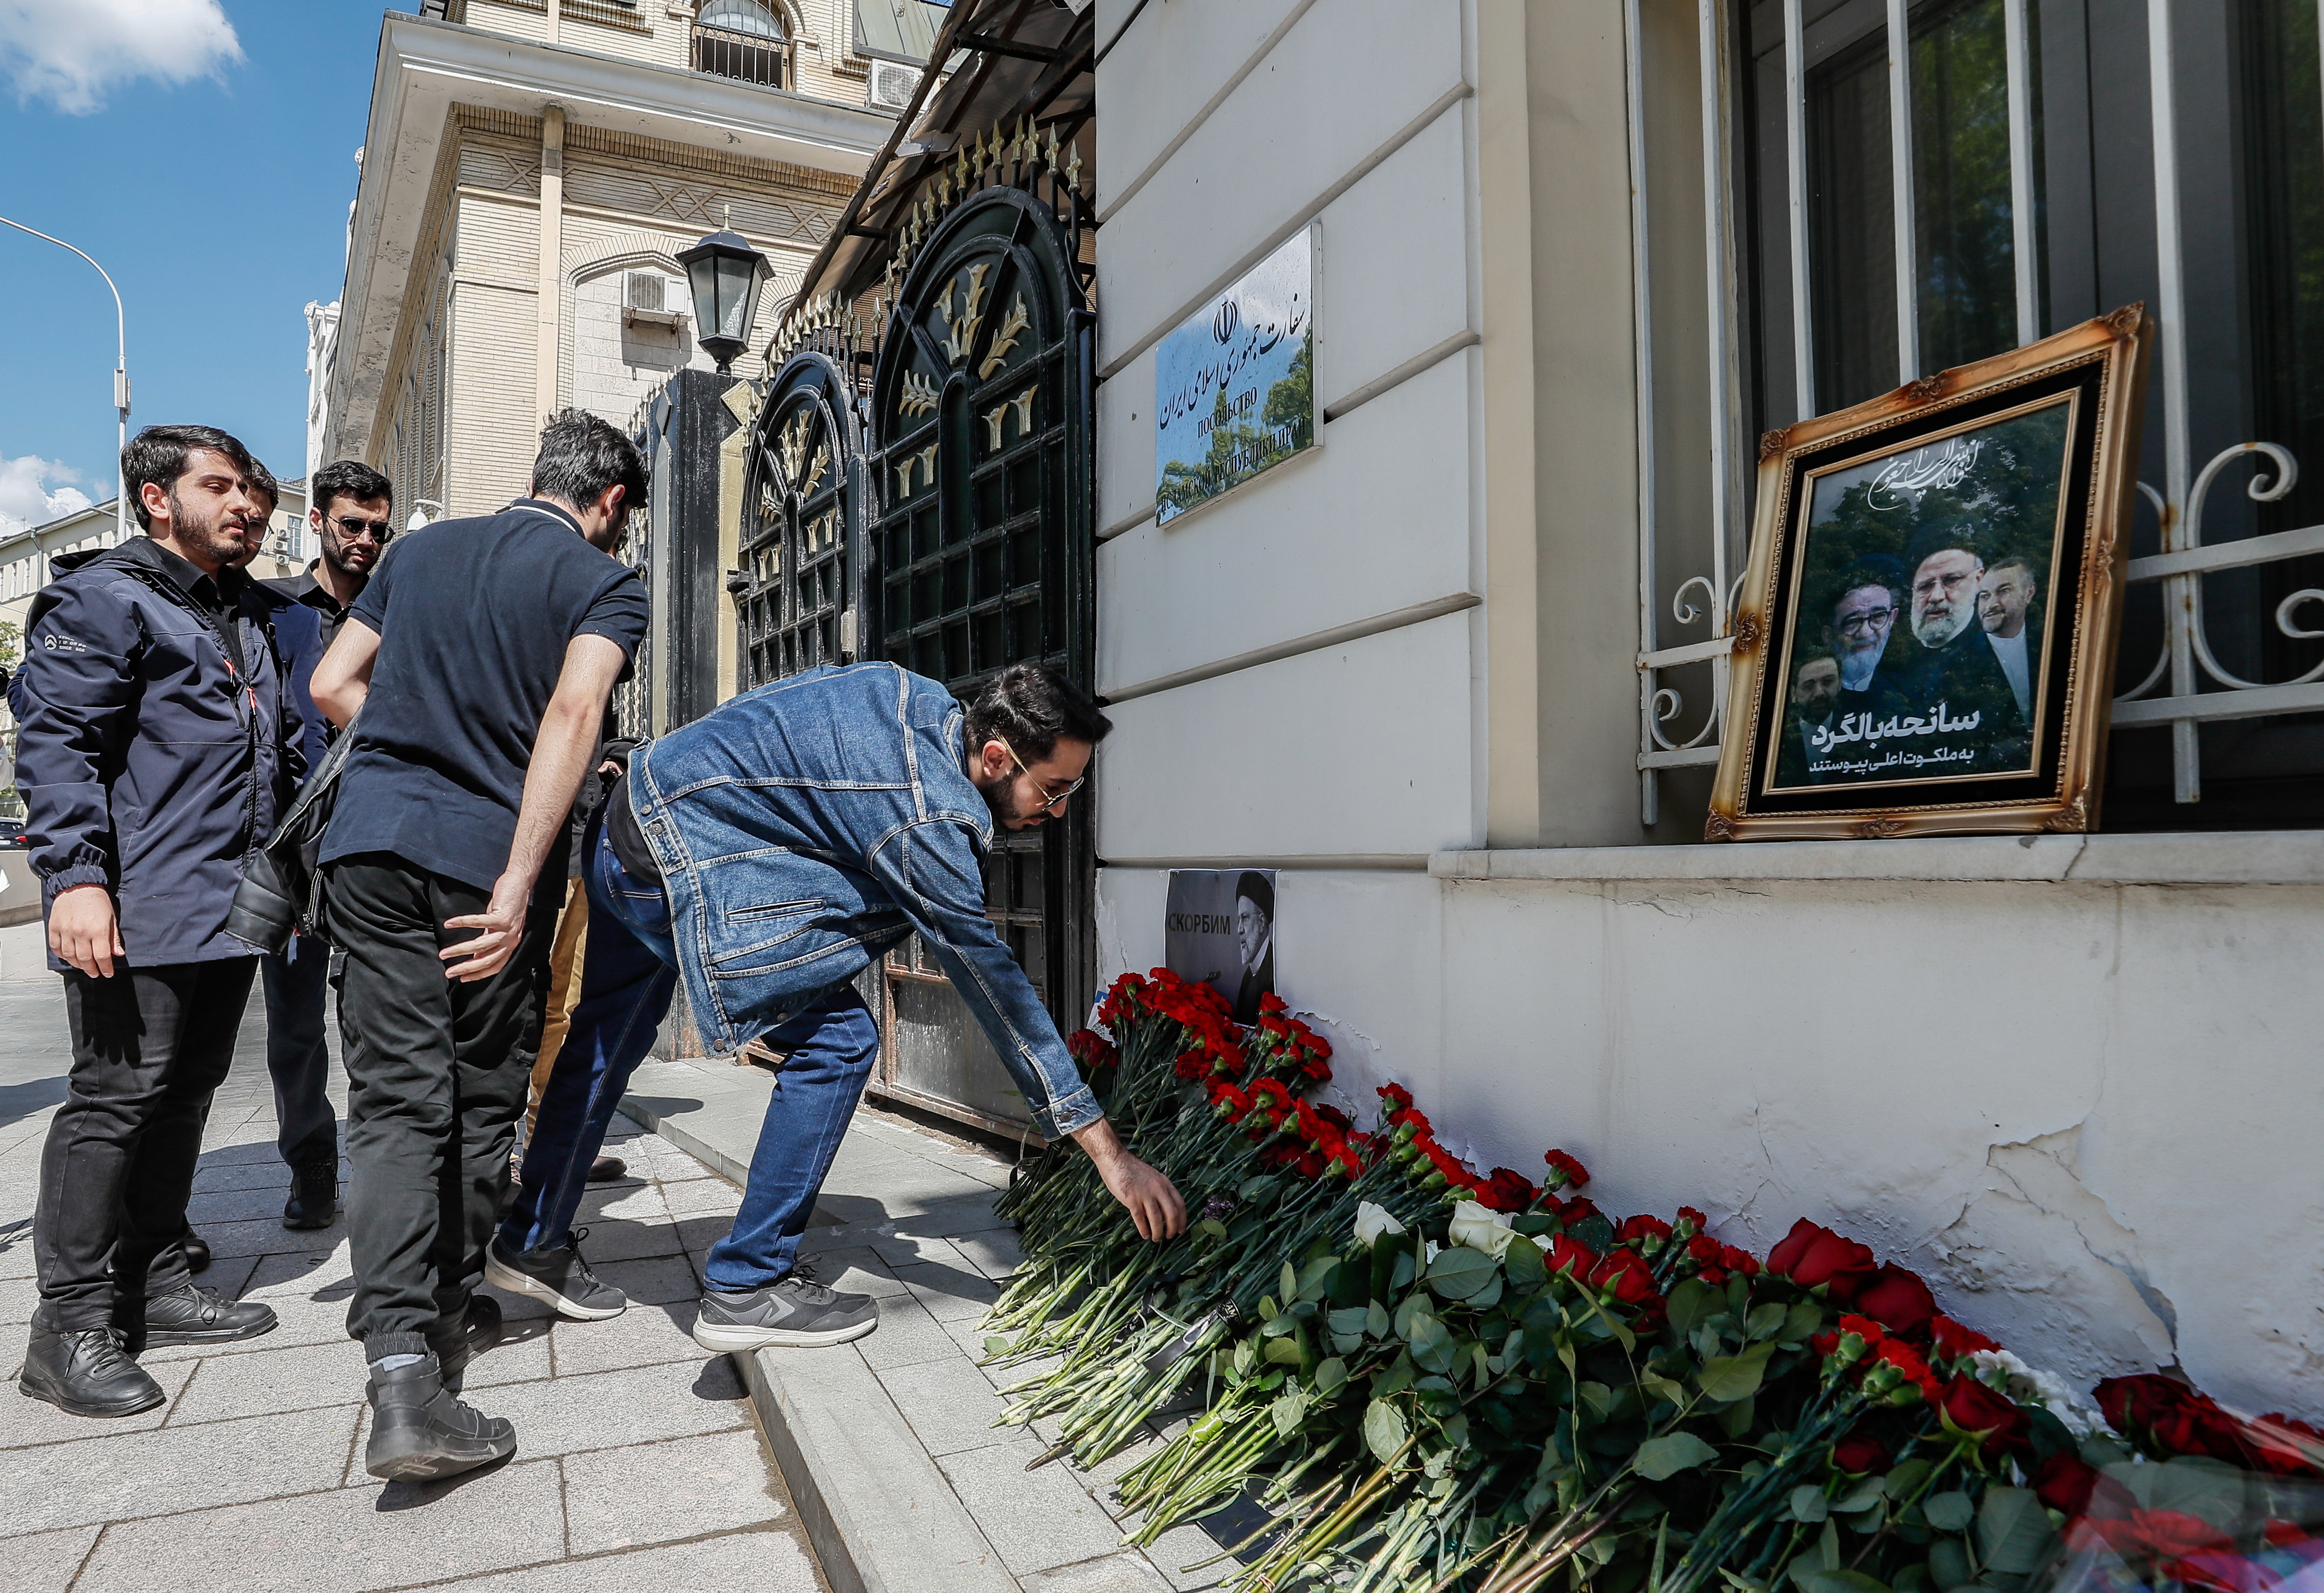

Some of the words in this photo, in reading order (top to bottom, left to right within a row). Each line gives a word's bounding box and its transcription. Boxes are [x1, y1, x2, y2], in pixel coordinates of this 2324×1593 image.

[1259, 292, 1305, 355] سفارت
[1160, 384, 1186, 430] ایران
[1197, 386, 1257, 439] ПОСОЛЬСТВО
[1160, 466, 1211, 513] ИСЛАМСКОЙ
[1214, 433, 1276, 483] РЕСПУБЛИКИ
[1277, 416, 1305, 449] ИРАН
[1811, 711, 1884, 753] بالگرد
[1883, 702, 1980, 737] سانحه
[1809, 758, 1869, 775] پیوستند
[1868, 750, 1903, 772] اعلی
[1903, 747, 1958, 768] ملکوت
[1958, 749, 1975, 764] به
[1167, 913, 1231, 935] СКОРБИМ
